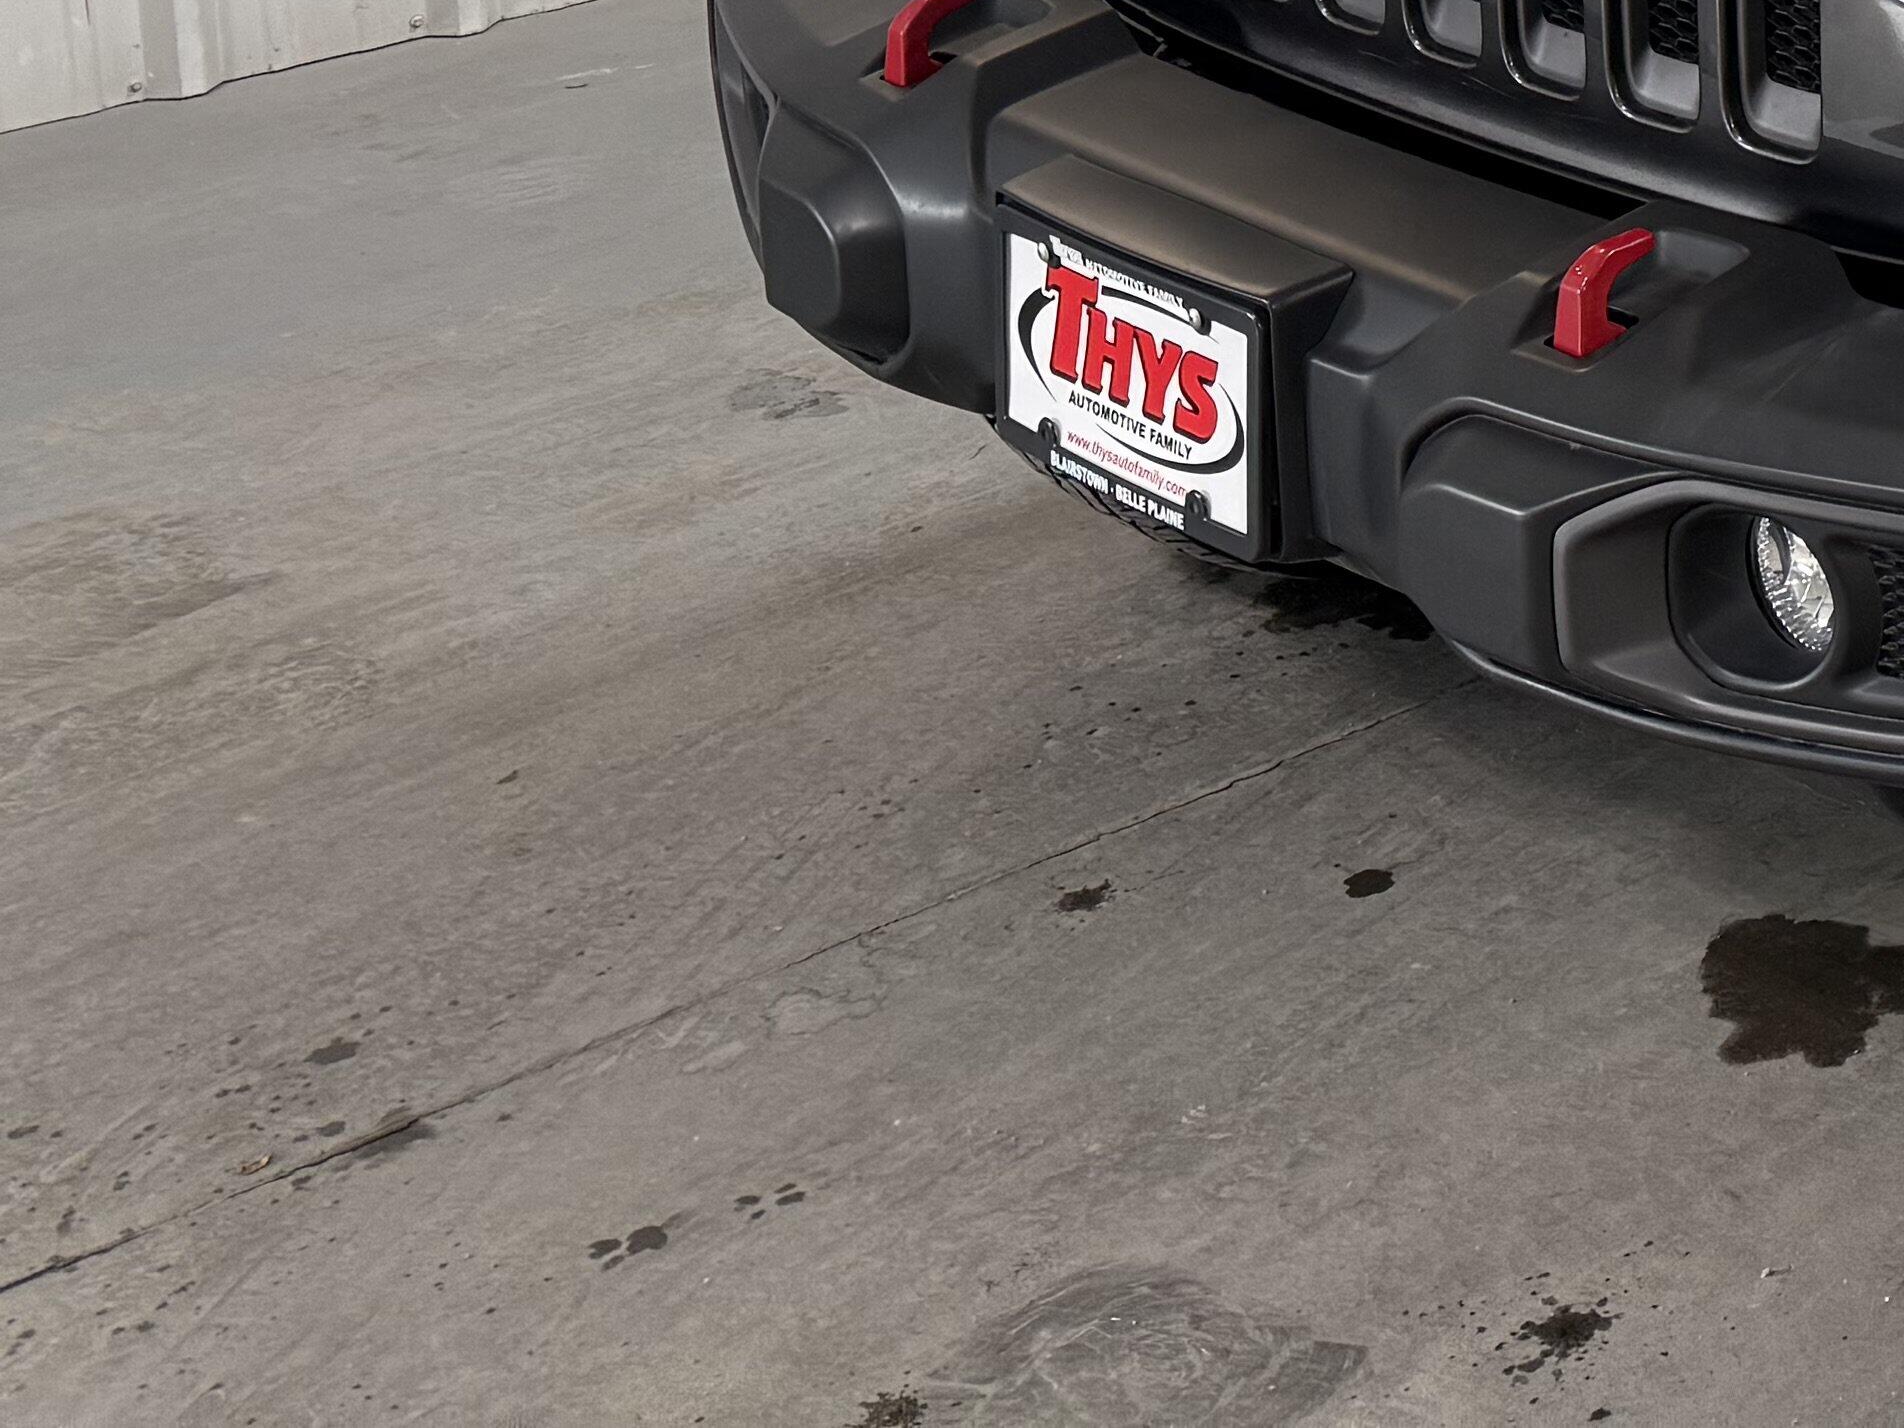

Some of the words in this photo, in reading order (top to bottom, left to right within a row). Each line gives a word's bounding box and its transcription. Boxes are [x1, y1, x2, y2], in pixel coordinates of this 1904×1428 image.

[1046, 262, 1219, 445] THYS
[1068, 390, 1147, 439] AUTOMOTIVE
[1150, 428, 1192, 460] FAMILY
[1115, 483, 1146, 512] BELLE
[1147, 499, 1185, 531] PLAINE
